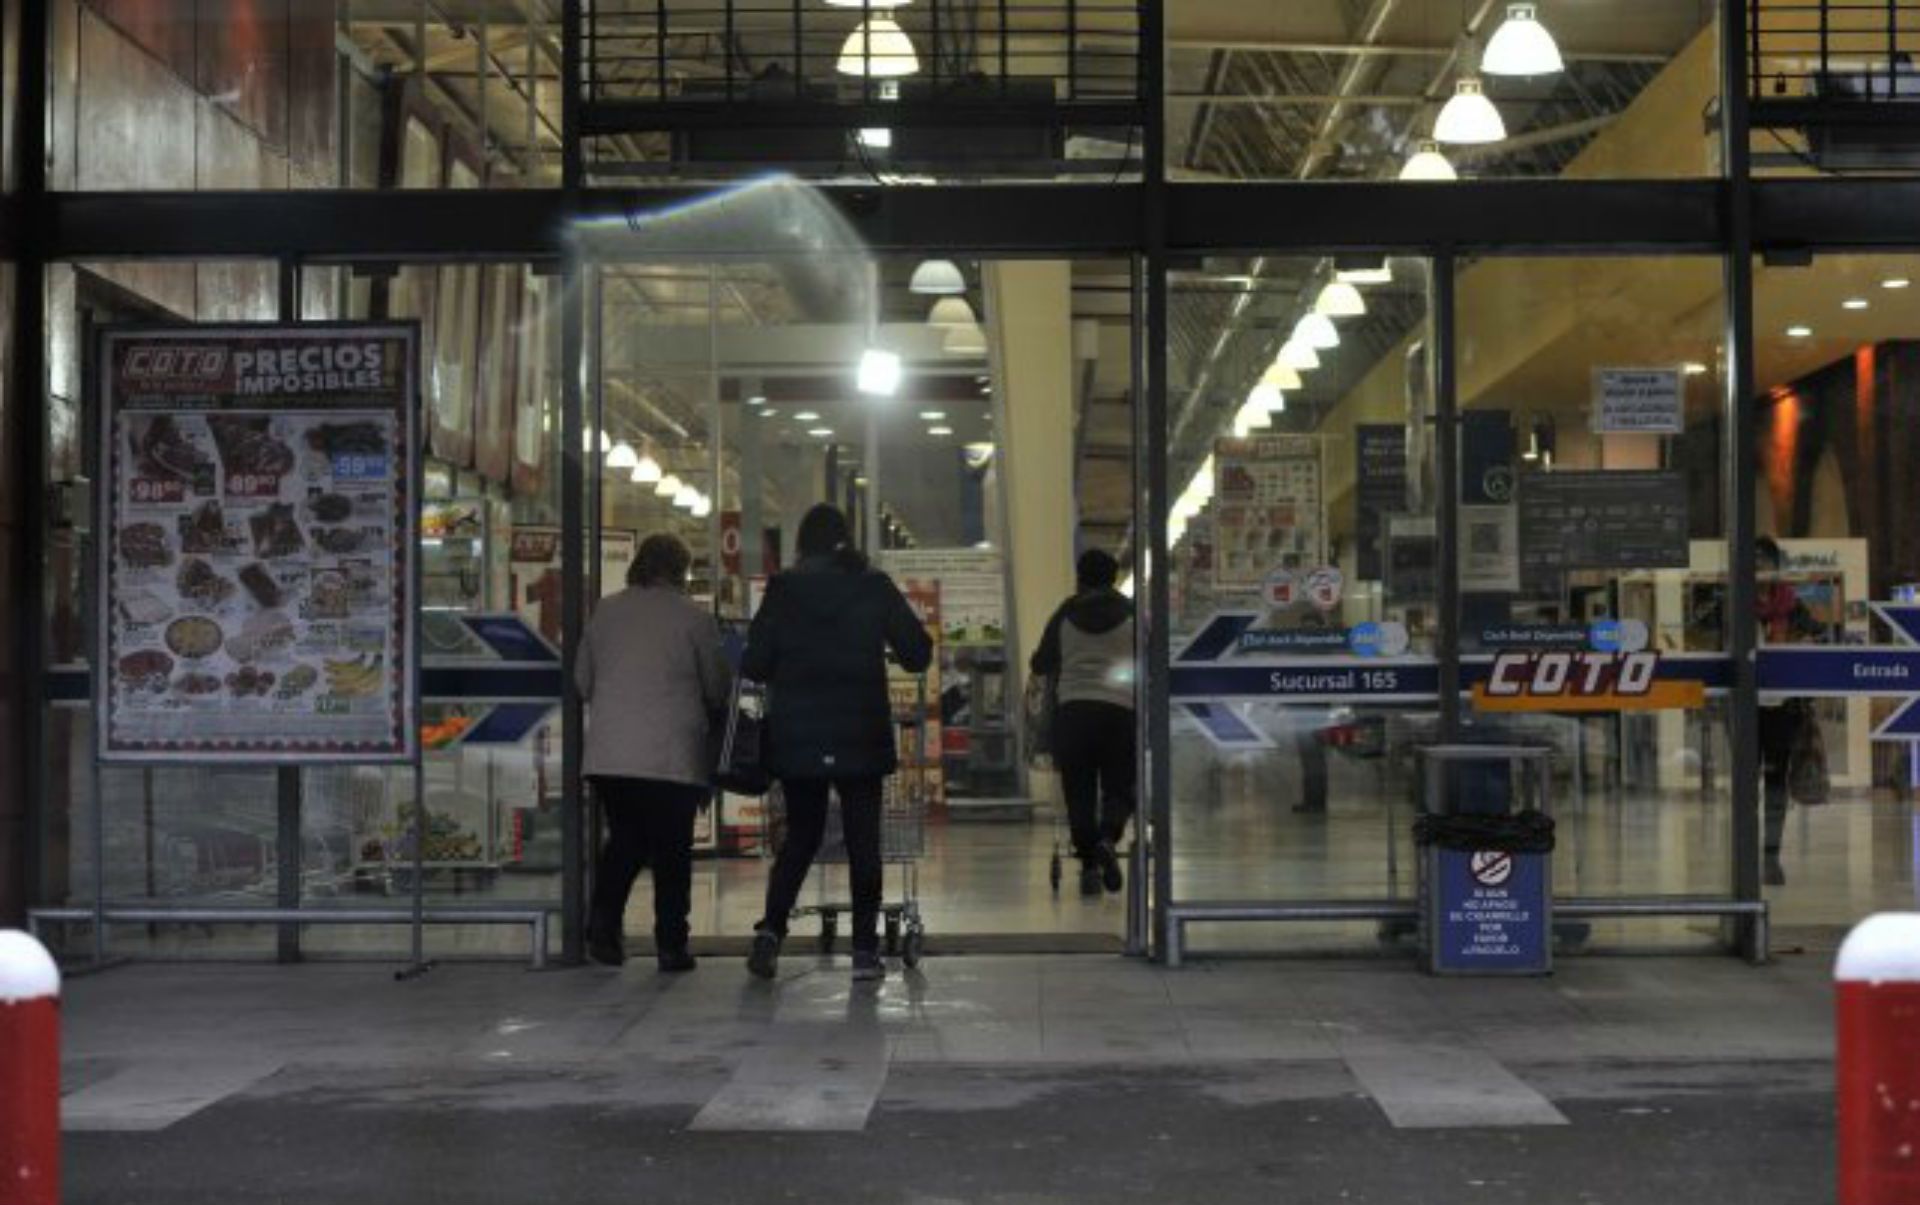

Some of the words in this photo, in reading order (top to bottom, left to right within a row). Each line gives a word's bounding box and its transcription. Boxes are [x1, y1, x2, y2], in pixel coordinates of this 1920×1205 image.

[126, 347, 226, 377] COTO
[233, 343, 382, 375] PRECIOS
[236, 371, 382, 394] IMPOSIBLES
[1270, 671, 1355, 690] Sucursal
[1362, 672, 1398, 689] 165
[1487, 651, 1657, 695] COTO
[1853, 663, 1909, 678] Entrada
